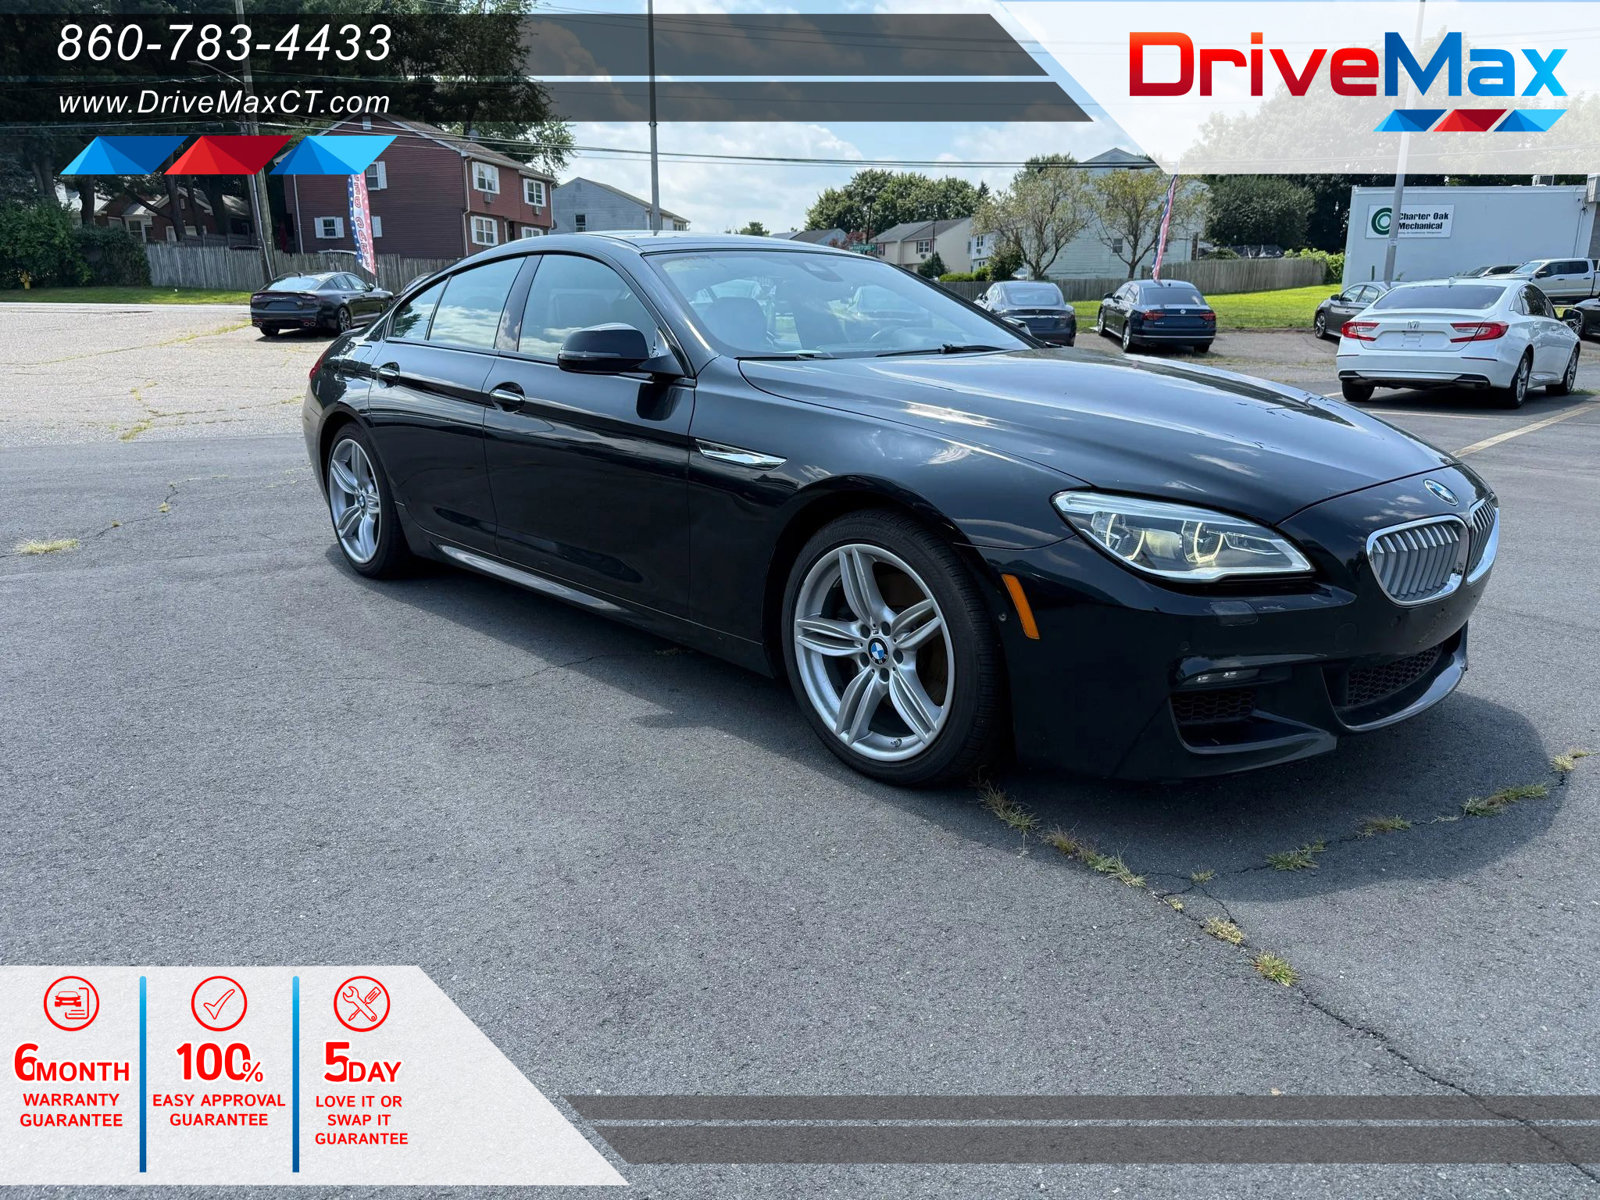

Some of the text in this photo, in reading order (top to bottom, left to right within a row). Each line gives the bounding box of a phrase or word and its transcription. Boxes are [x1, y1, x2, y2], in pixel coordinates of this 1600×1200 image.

[1399, 212, 1449, 221] Charter Oak
[1398, 221, 1443, 230] Mechanical
